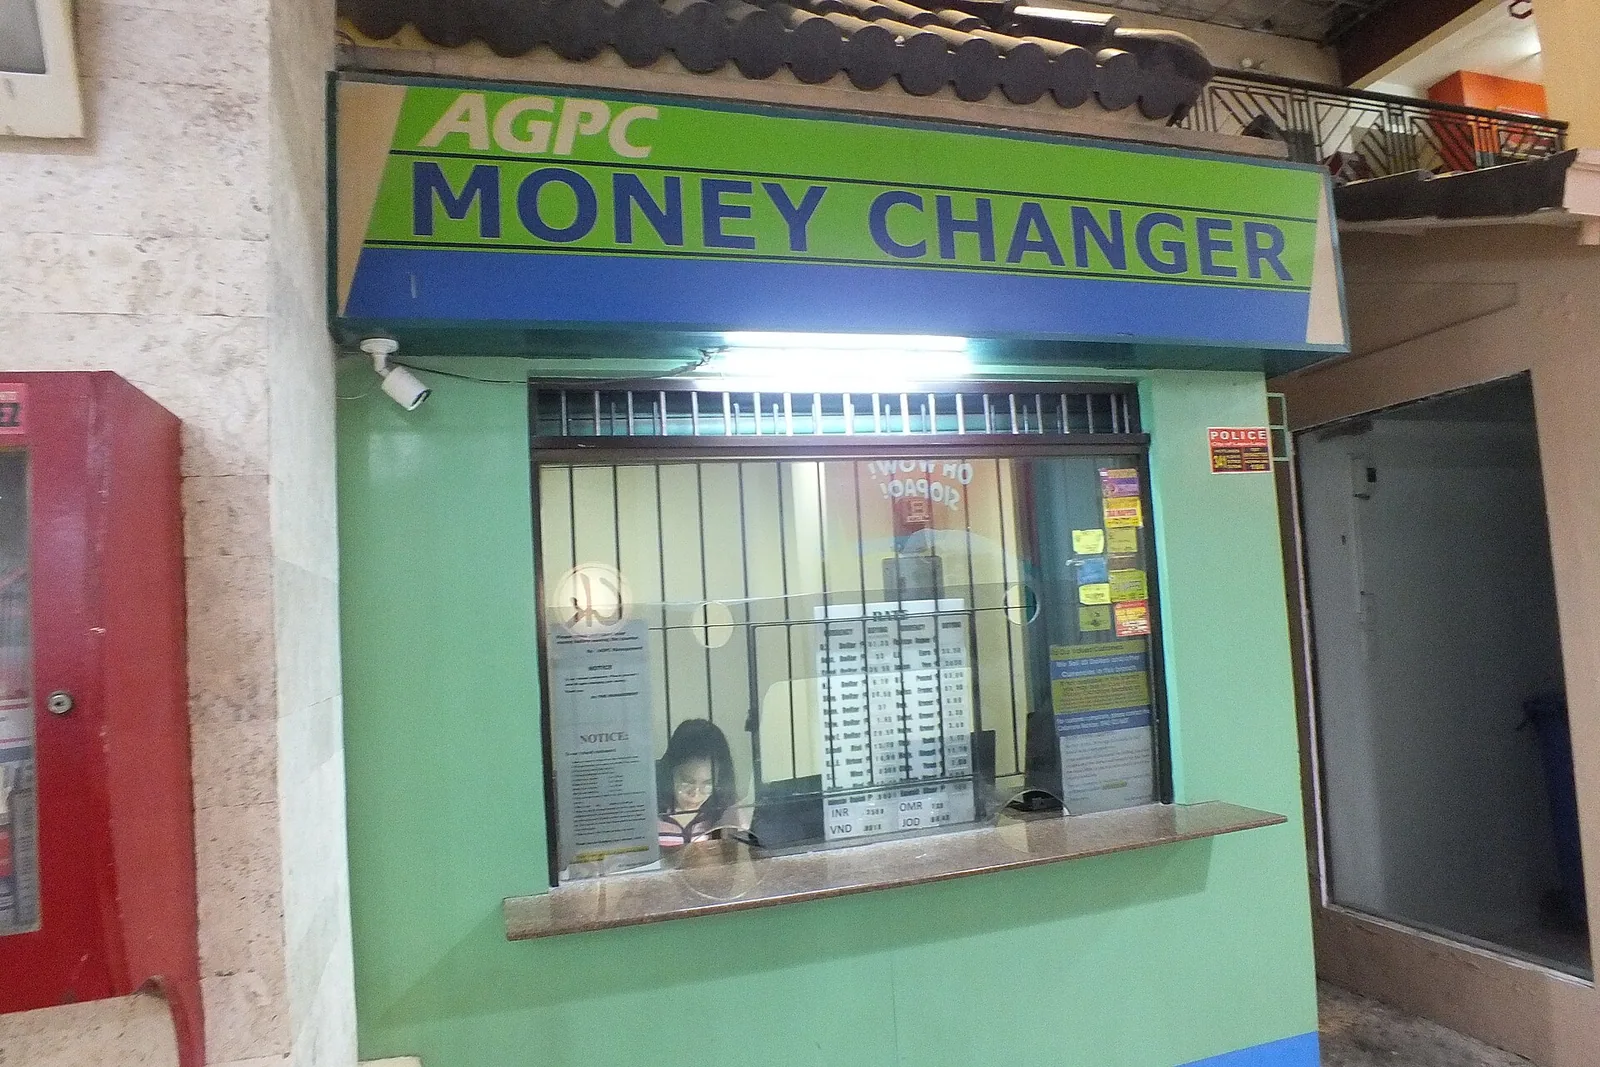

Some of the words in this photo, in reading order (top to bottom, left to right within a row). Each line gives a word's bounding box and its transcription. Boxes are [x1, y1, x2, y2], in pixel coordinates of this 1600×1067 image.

[419, 92, 660, 159] AGPC
[412, 161, 828, 253] MONEY
[868, 190, 1294, 282] CHANGER
[1210, 430, 1267, 440] POLICE
[831, 808, 849, 818] INR
[829, 824, 852, 835] VND
